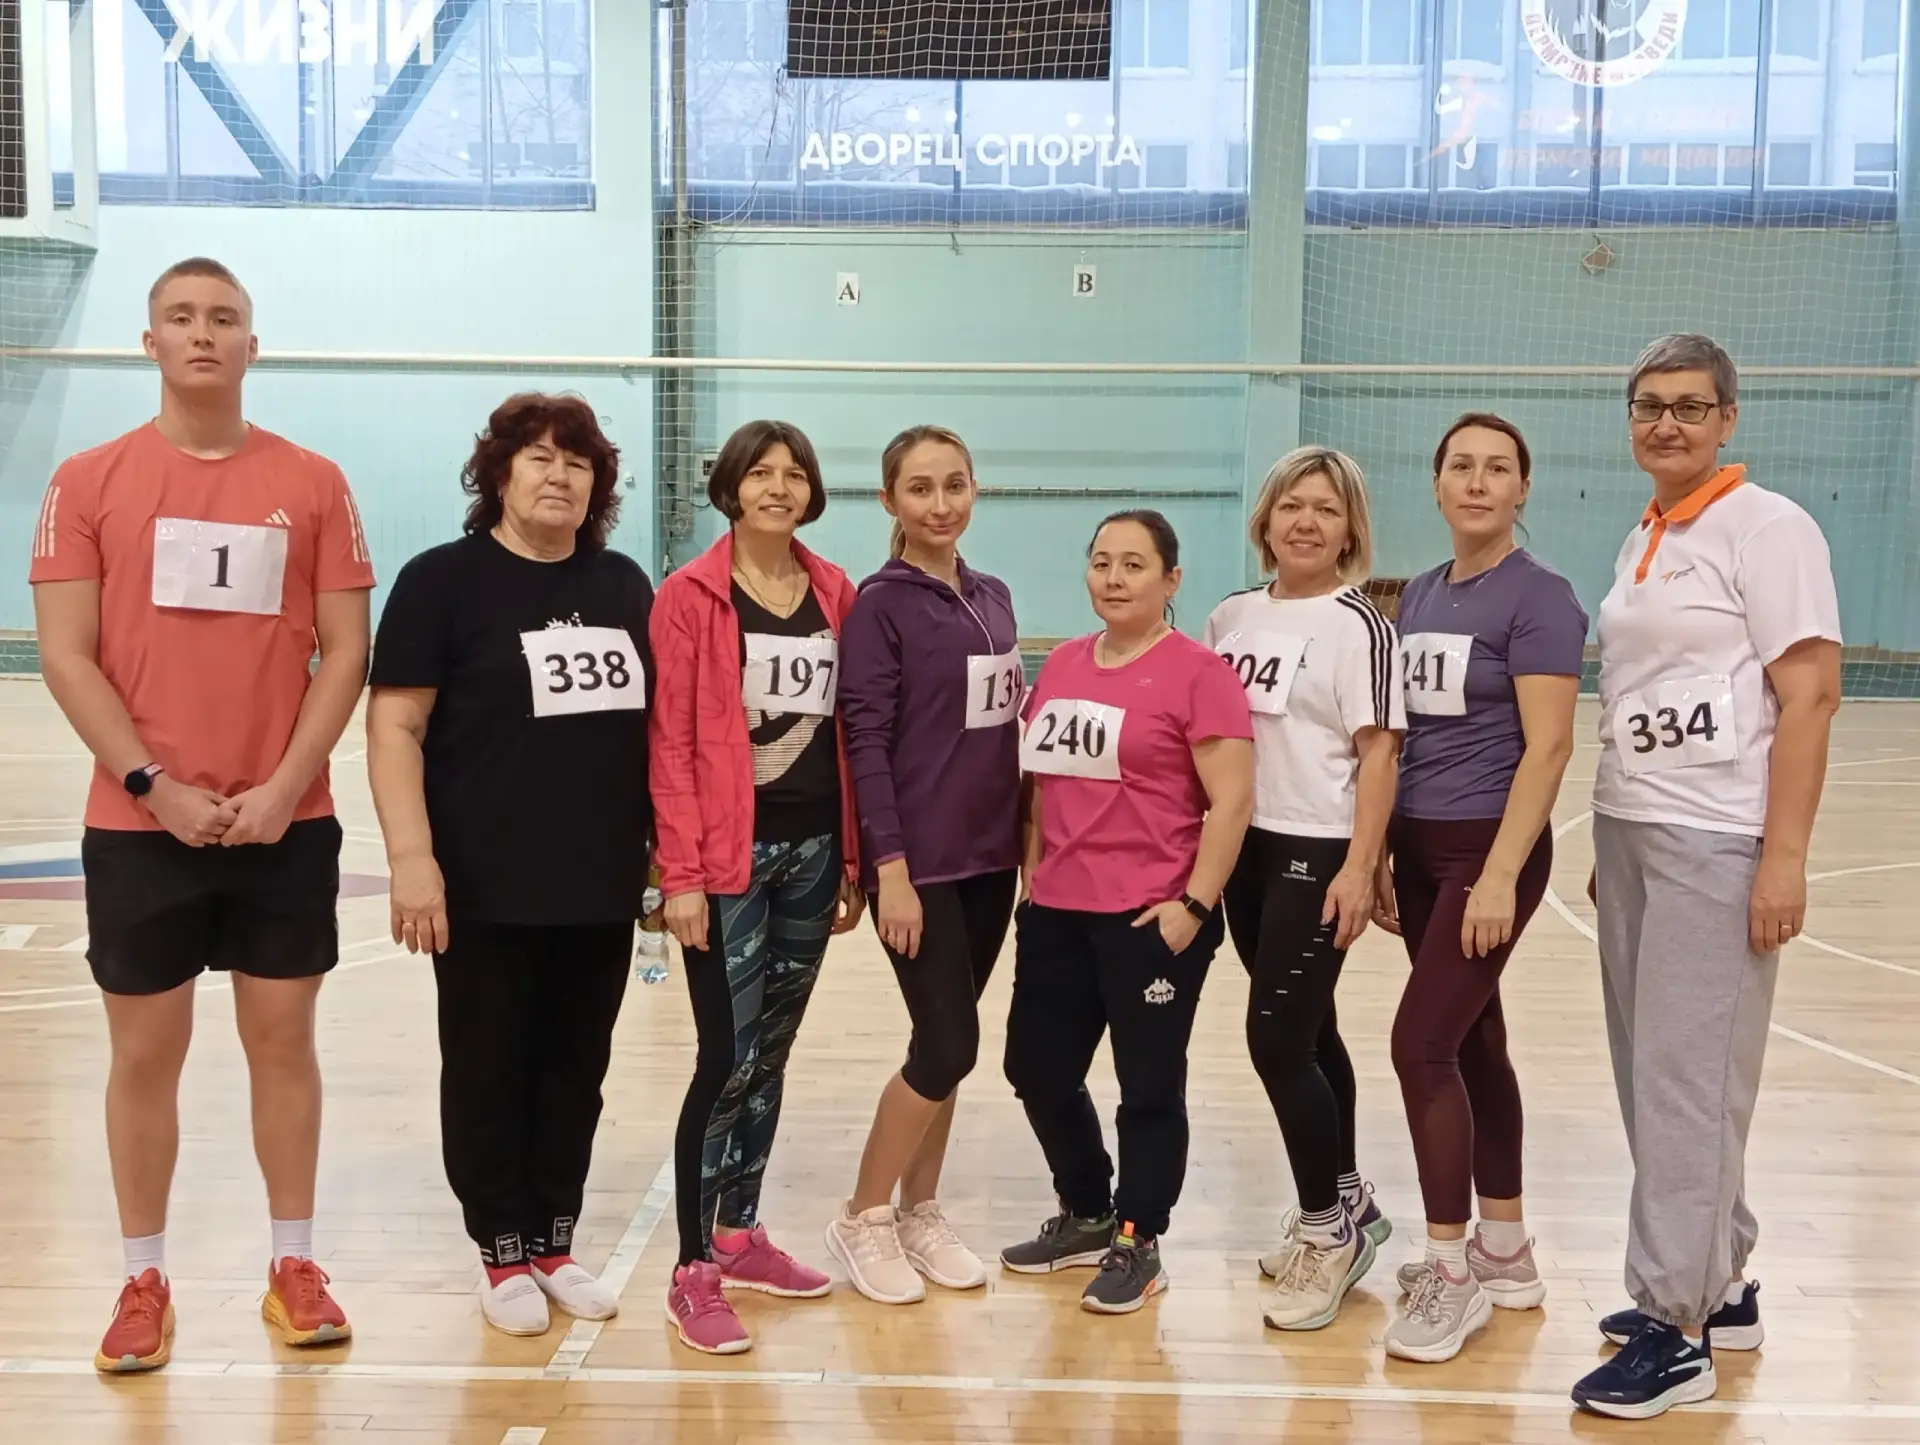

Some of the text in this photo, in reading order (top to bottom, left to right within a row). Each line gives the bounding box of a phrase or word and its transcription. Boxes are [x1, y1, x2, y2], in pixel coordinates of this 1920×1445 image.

[161, 0, 435, 64] ЖИЗНИ
[800, 132, 1141, 171] ДВОРЕЦ СПОРТА
[839, 281, 856, 300] A
[208, 544, 234, 589] 1
[544, 650, 631, 693] 338
[763, 654, 835, 701] 197
[980, 663, 1022, 712] 139
[1035, 712, 1106, 758] 240
[1628, 702, 1718, 754] 334
